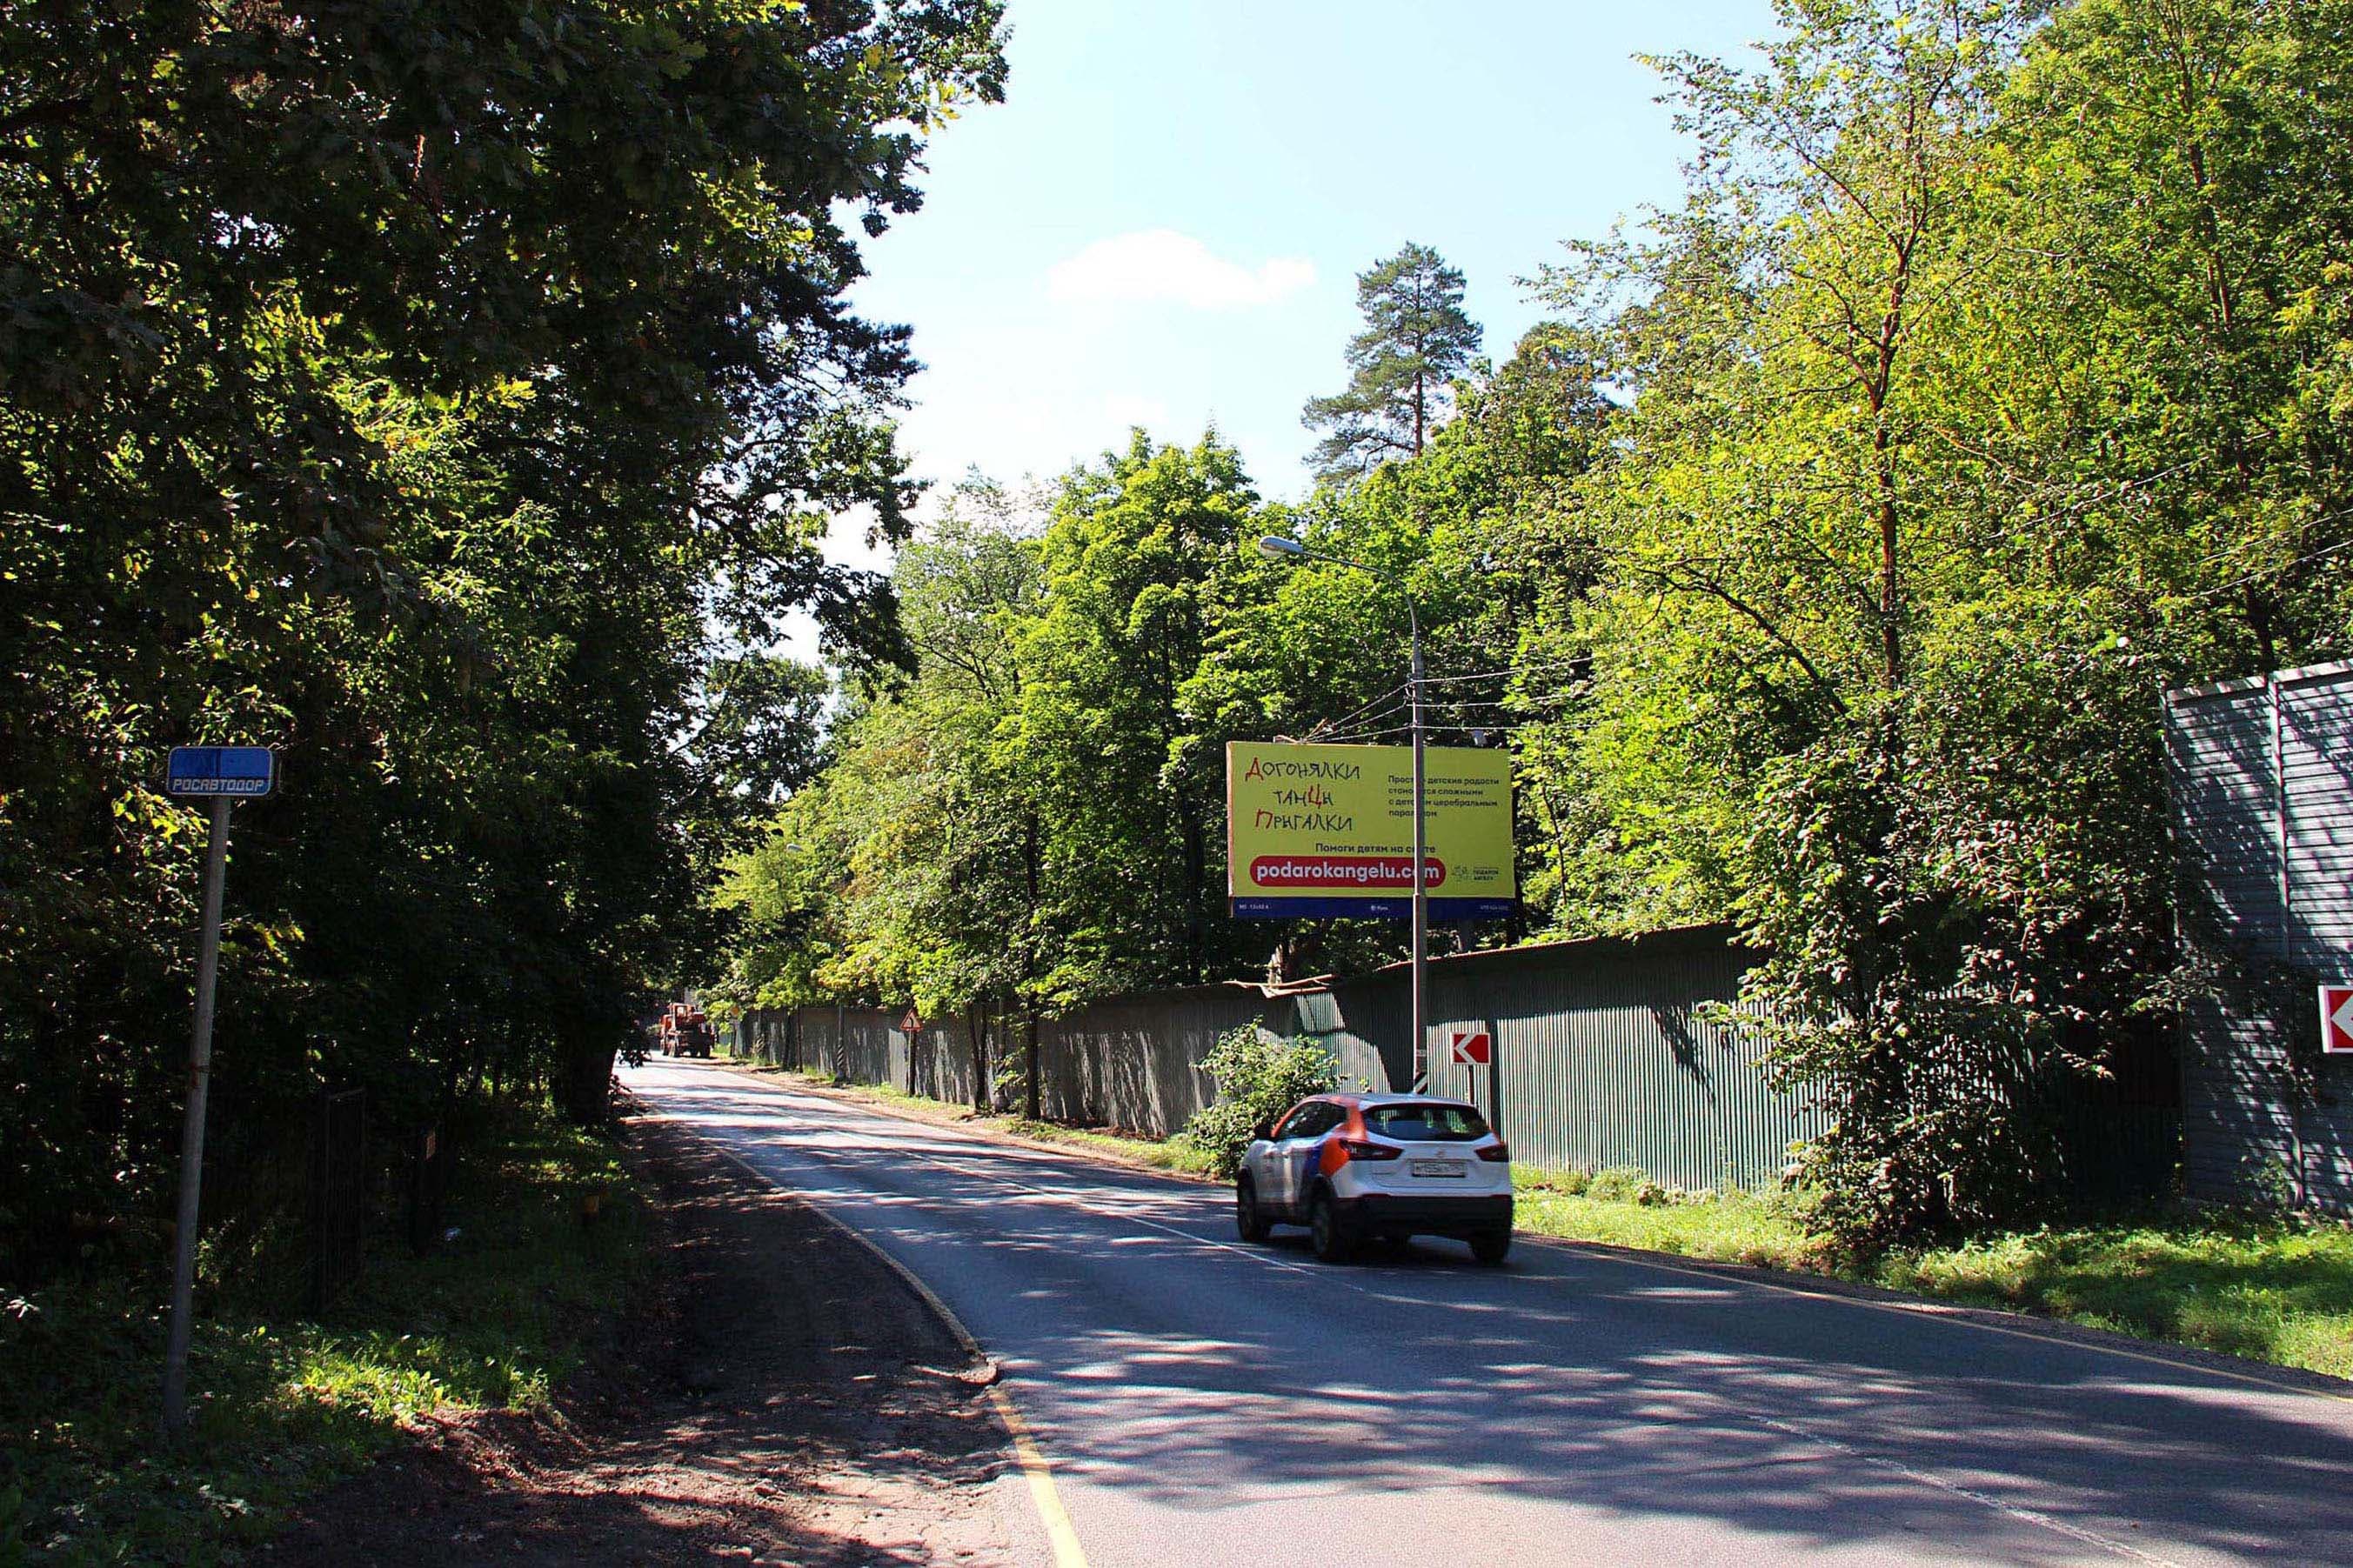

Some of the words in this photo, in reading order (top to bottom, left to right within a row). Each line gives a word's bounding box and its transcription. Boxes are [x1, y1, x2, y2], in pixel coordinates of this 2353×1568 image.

[172, 778, 264, 791] РОСАВТОДОР
[1388, 775, 1426, 784] Прост
[1433, 798, 1498, 808] церебральным
[1315, 843, 1354, 852] Помоги
[1357, 844, 1387, 853] детям
[1257, 861, 1440, 882] podarokangelu.cm
